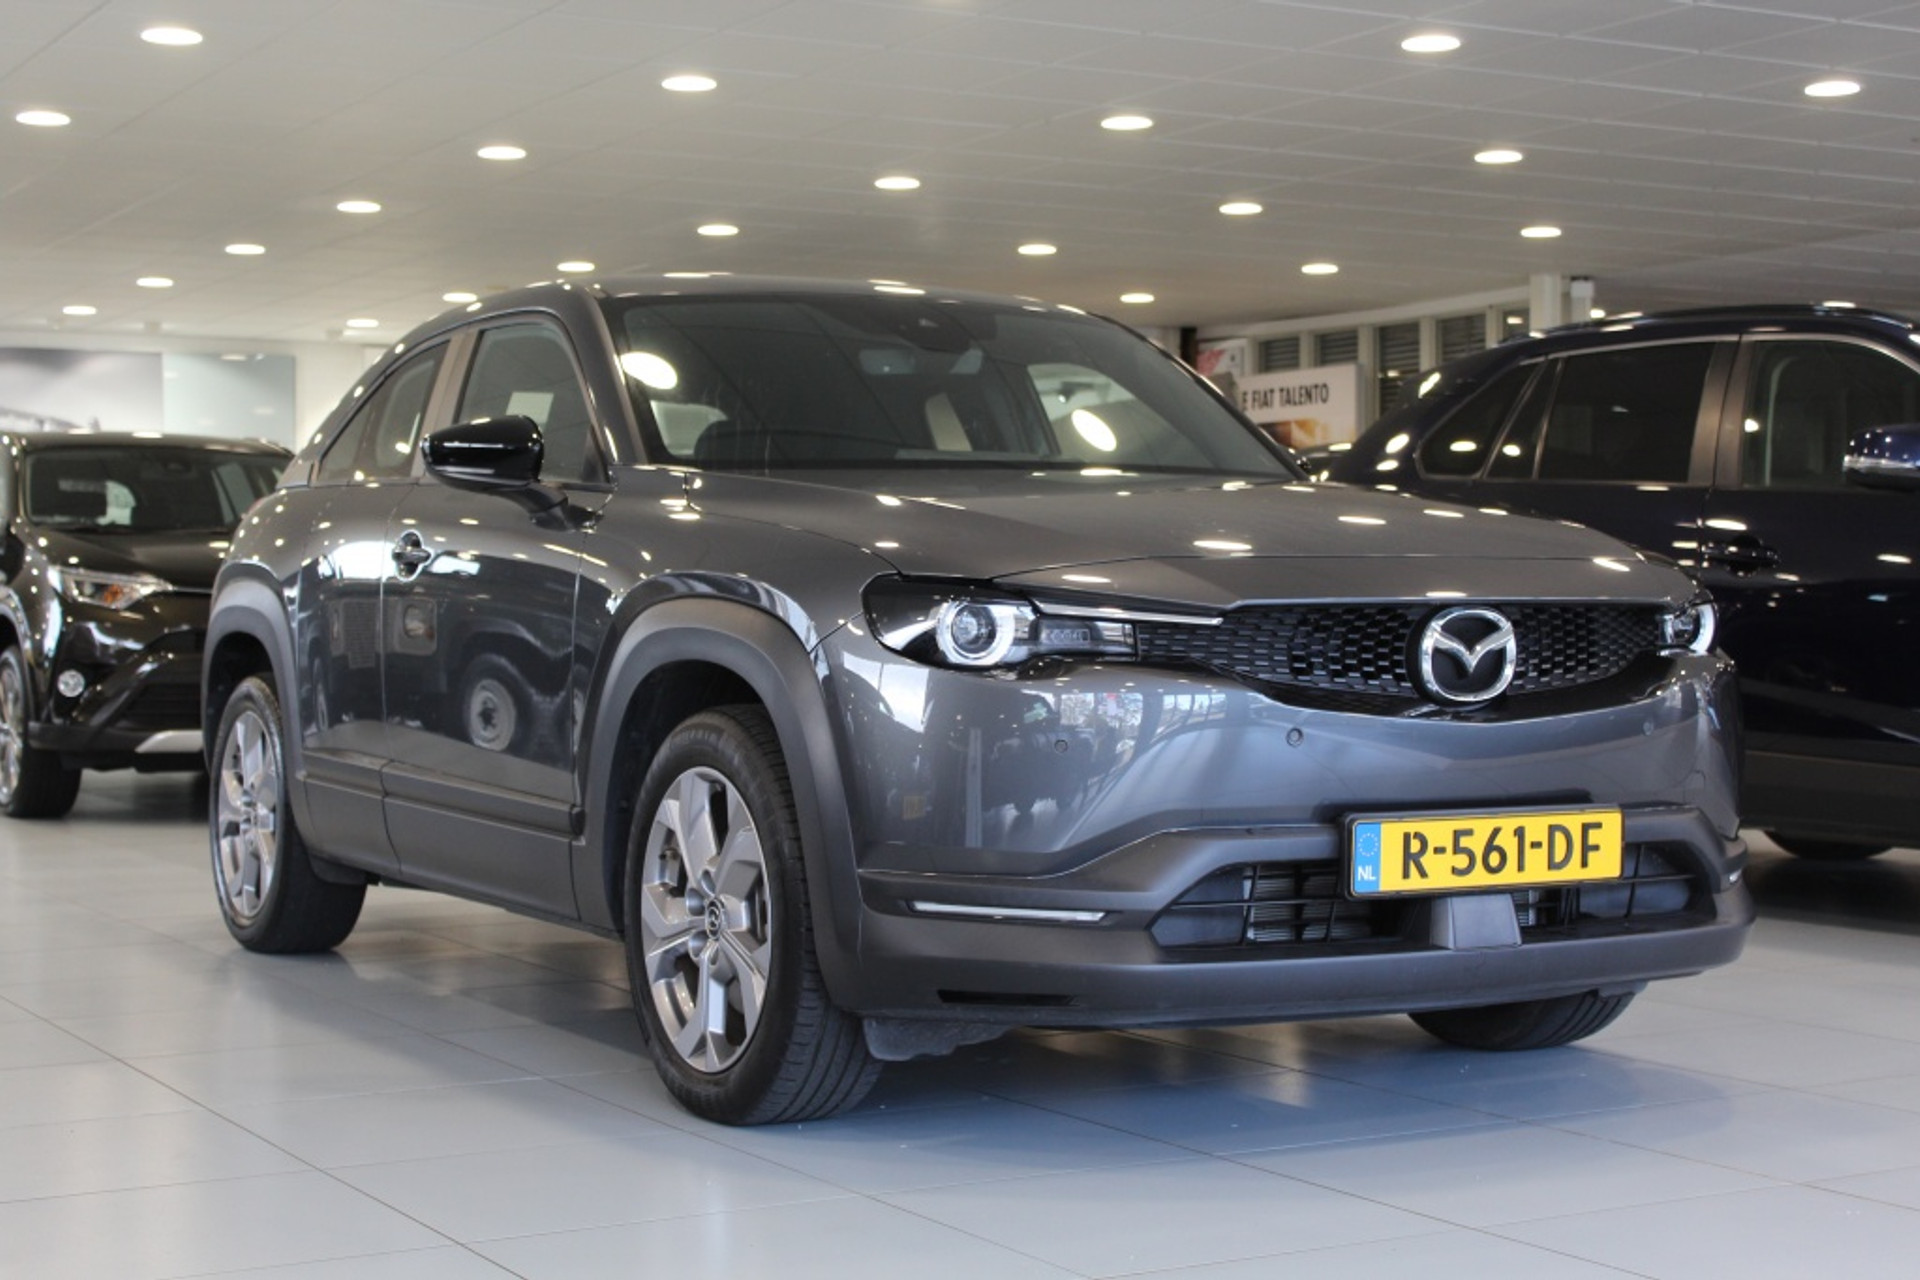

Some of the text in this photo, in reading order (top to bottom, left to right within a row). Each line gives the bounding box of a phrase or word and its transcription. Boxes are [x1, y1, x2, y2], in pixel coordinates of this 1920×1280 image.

[1252, 388, 1275, 410] FIAT
[1279, 383, 1329, 407] TALENTO
[1402, 822, 1603, 879] R-561-DF
[1357, 864, 1376, 881] NL
